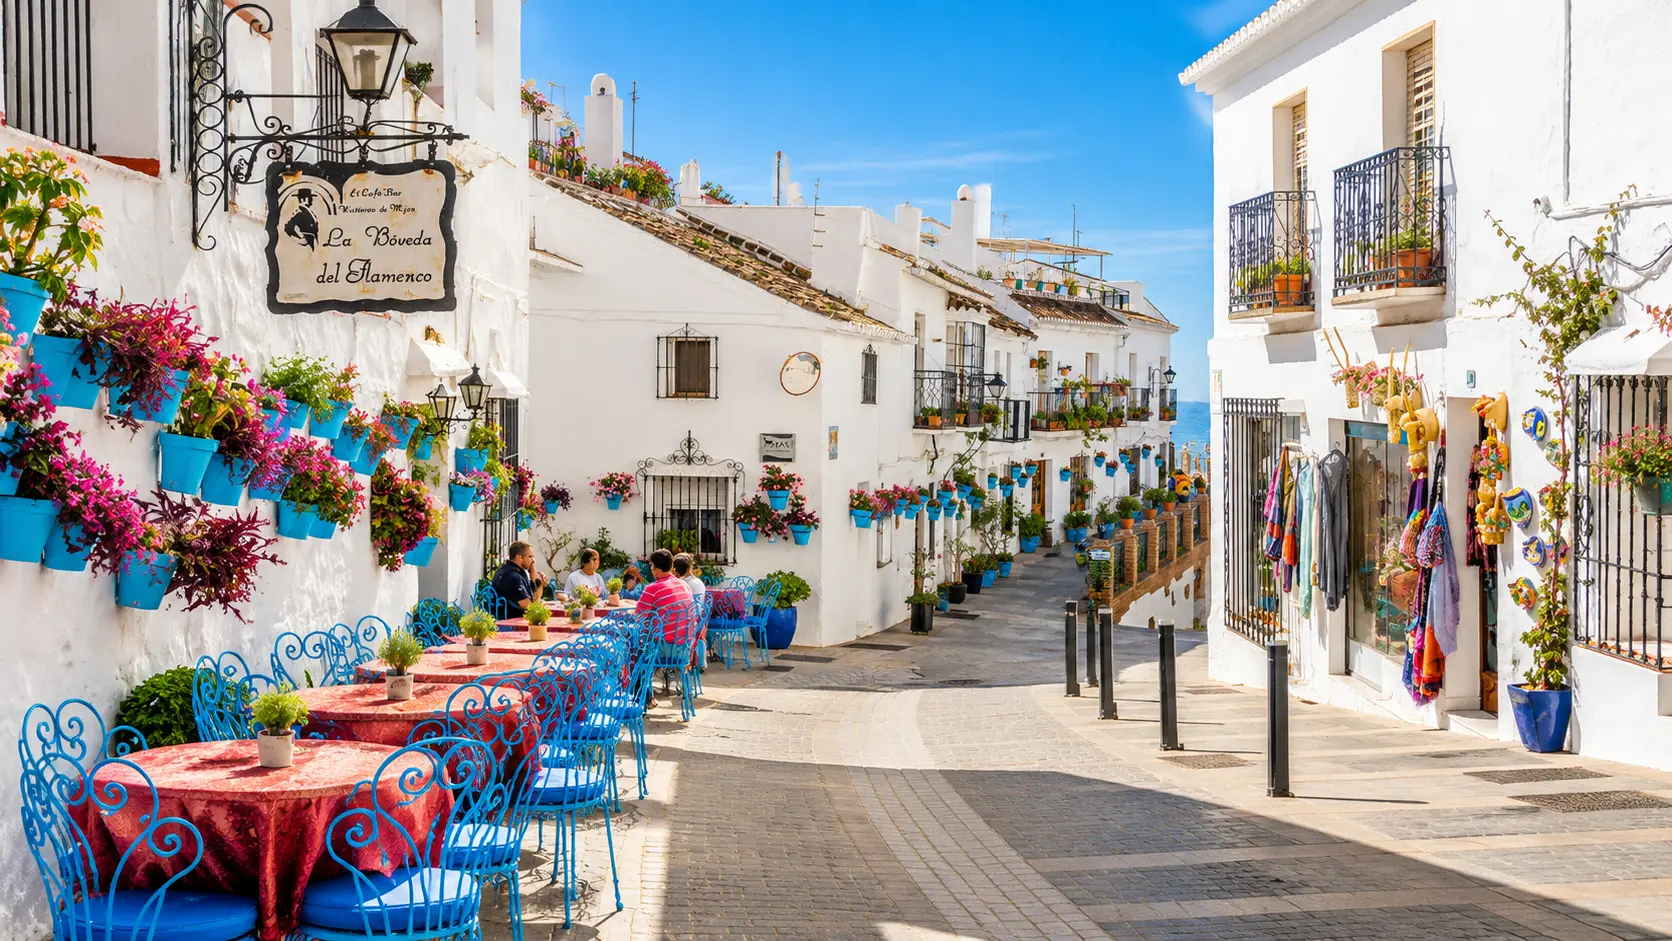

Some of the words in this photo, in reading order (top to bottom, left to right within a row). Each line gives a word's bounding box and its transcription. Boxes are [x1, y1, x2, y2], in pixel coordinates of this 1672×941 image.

[322, 228, 352, 248] La
[365, 225, 432, 247] Bóveda
[316, 262, 341, 284] del
[345, 258, 432, 284] Flamenco
